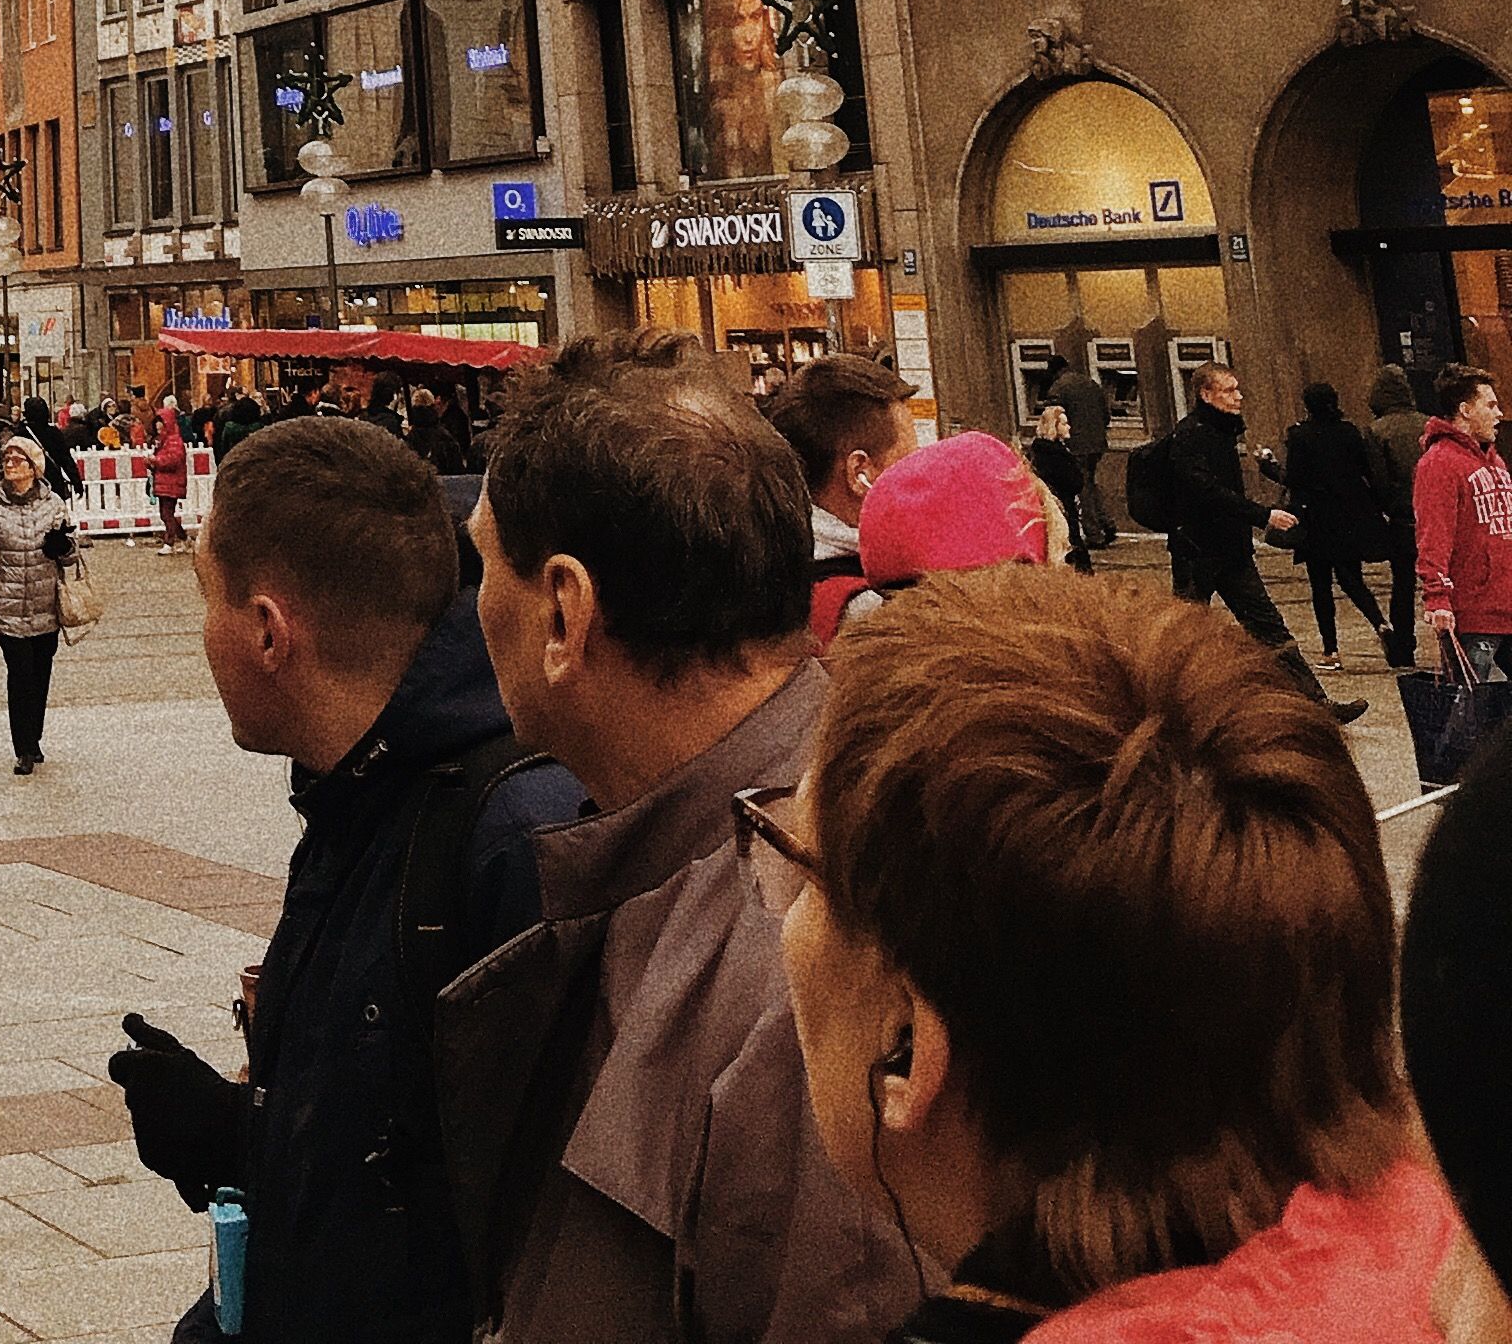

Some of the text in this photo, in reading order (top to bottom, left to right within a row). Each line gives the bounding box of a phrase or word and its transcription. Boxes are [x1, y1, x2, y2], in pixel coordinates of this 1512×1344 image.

[1026, 207, 1143, 230] Deutsche Bank
[518, 227, 573, 240] SWAROVSKI
[674, 212, 783, 248] SWAROVSKI
[810, 243, 843, 255] ZONE
